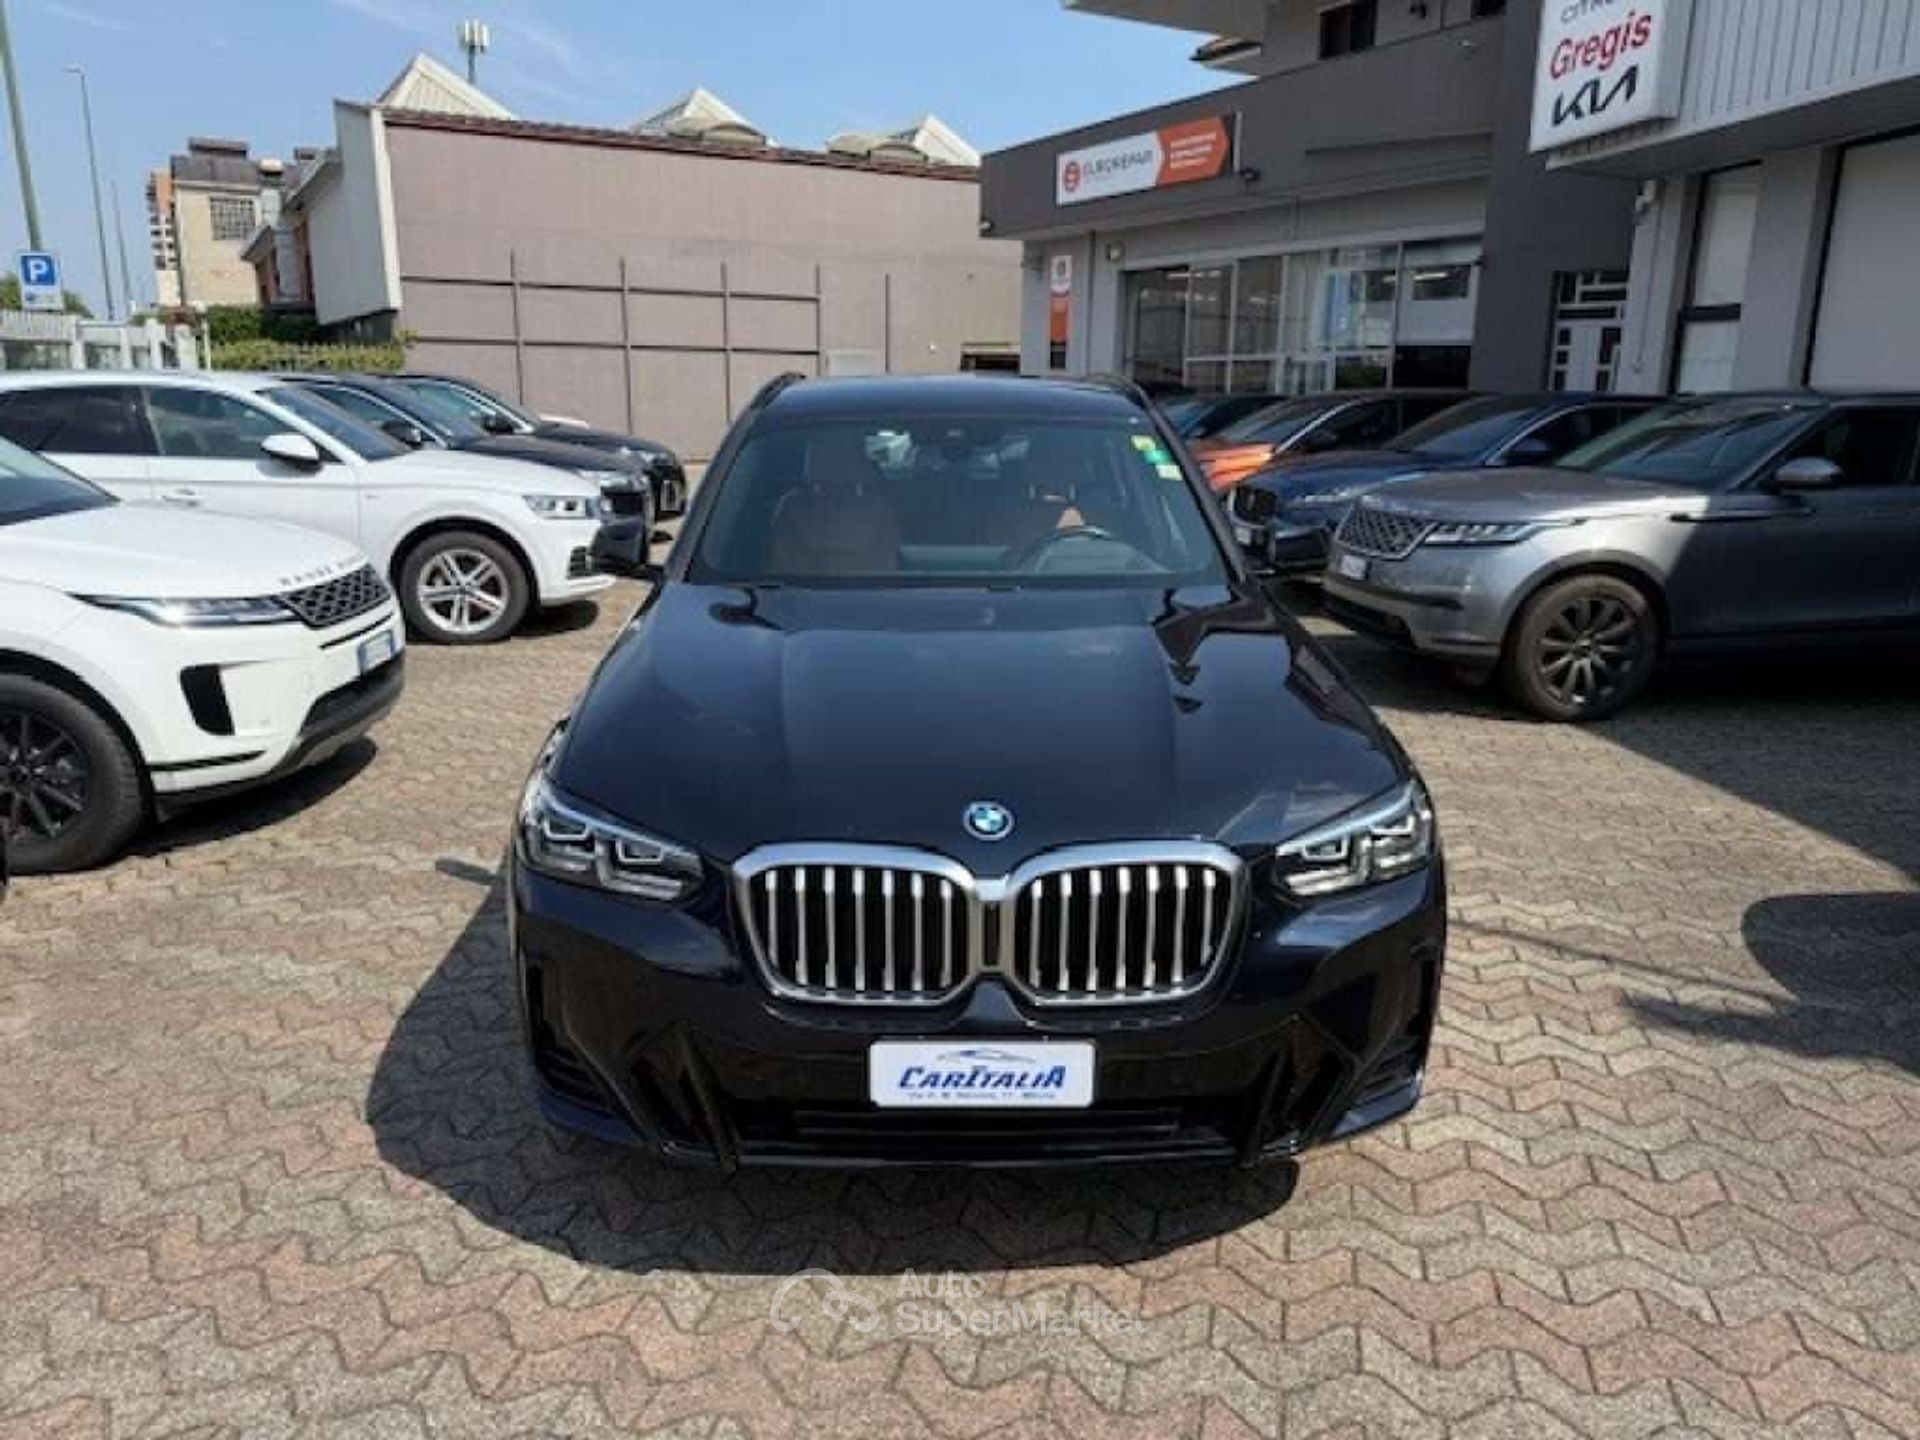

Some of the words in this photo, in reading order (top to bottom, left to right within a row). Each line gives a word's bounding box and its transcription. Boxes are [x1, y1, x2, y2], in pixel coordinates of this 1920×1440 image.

[1550, 10, 1652, 79] Gregis
[1552, 64, 1639, 126] KIA
[29, 259, 48, 281] P
